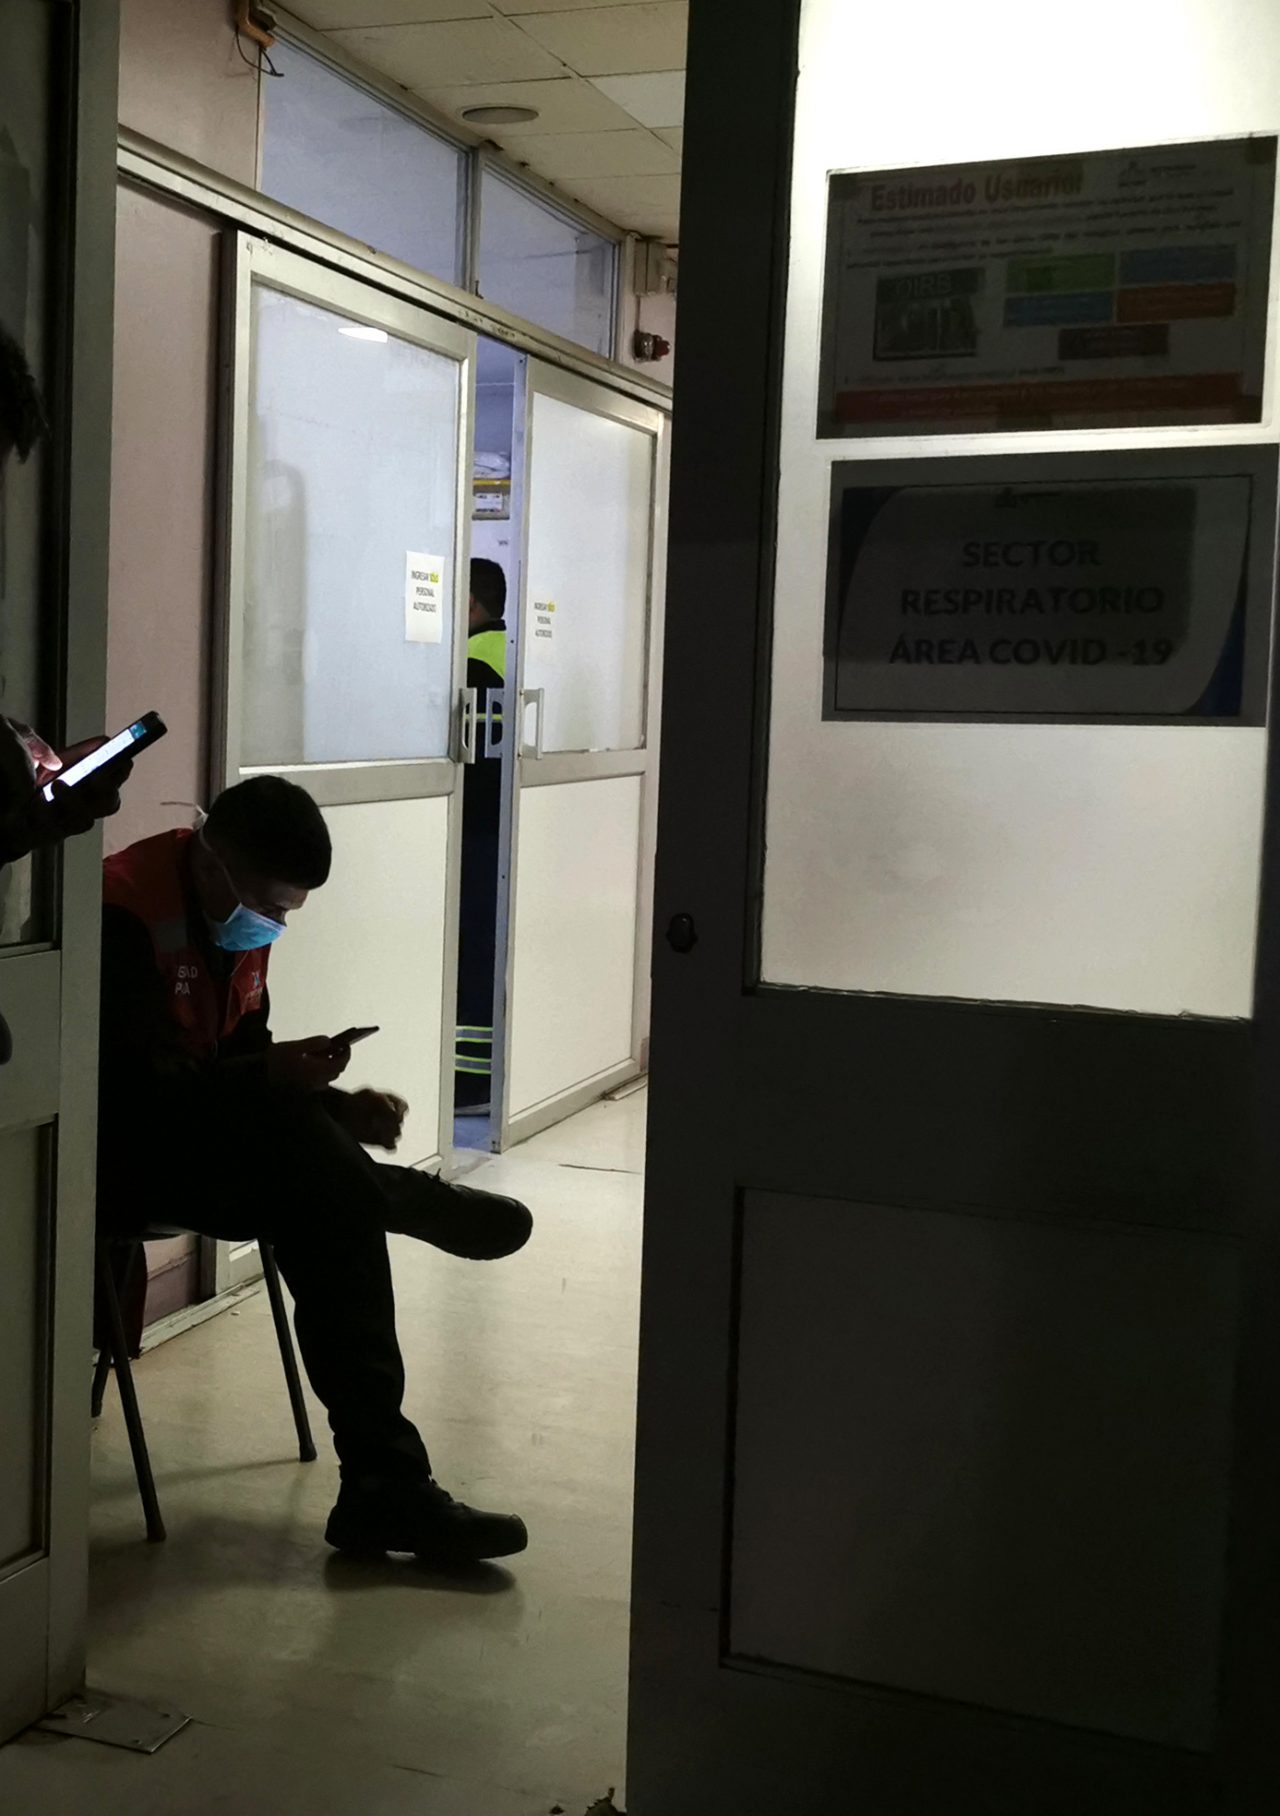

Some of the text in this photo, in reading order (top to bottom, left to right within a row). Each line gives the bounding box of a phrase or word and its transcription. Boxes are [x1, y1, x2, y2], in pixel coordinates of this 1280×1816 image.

[871, 177, 977, 211] Estimado
[962, 539, 1103, 569] SECTOR
[900, 586, 1166, 616] RESPIRATORIO
[889, 633, 1175, 665] ÁREA COVID -19
